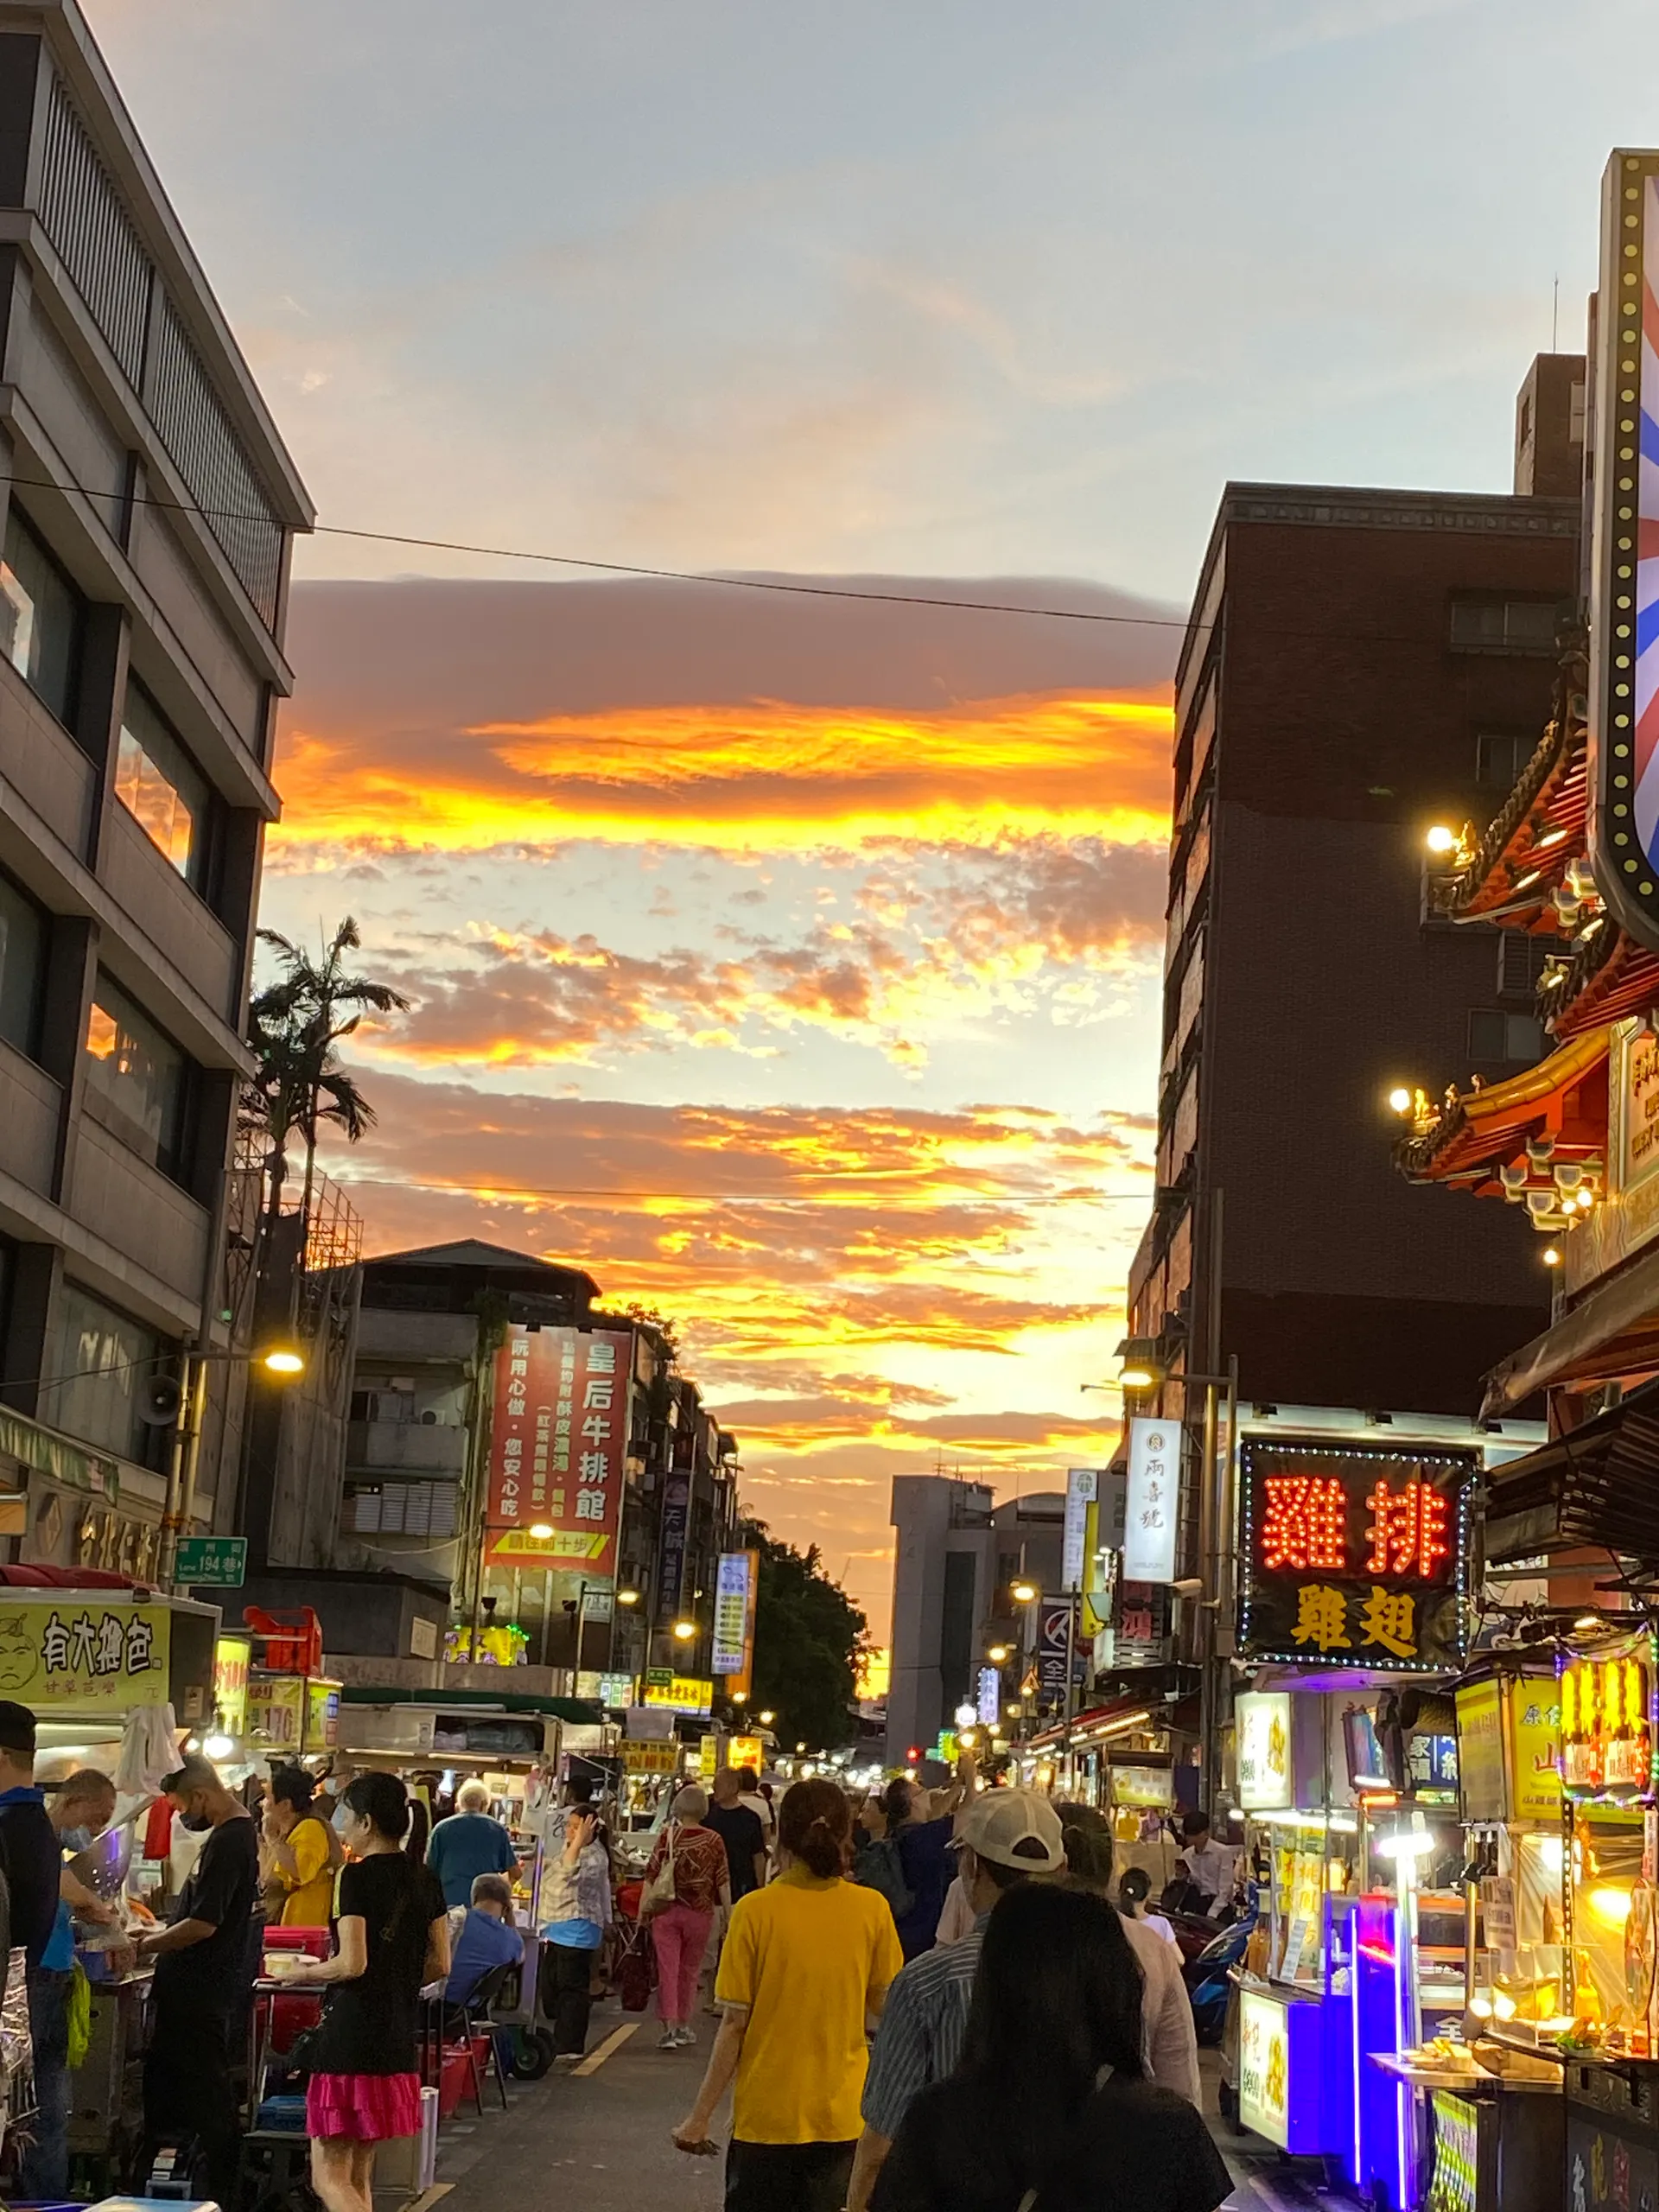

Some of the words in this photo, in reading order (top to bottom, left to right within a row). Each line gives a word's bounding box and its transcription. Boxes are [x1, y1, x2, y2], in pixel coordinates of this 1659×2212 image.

[575, 1343, 615, 1521] 皇后牛排館
[1261, 1476, 1448, 1577] 雞排
[1290, 1583, 1418, 1658] 雞翅
[44, 1678, 117, 1697] 甘草芭樂
